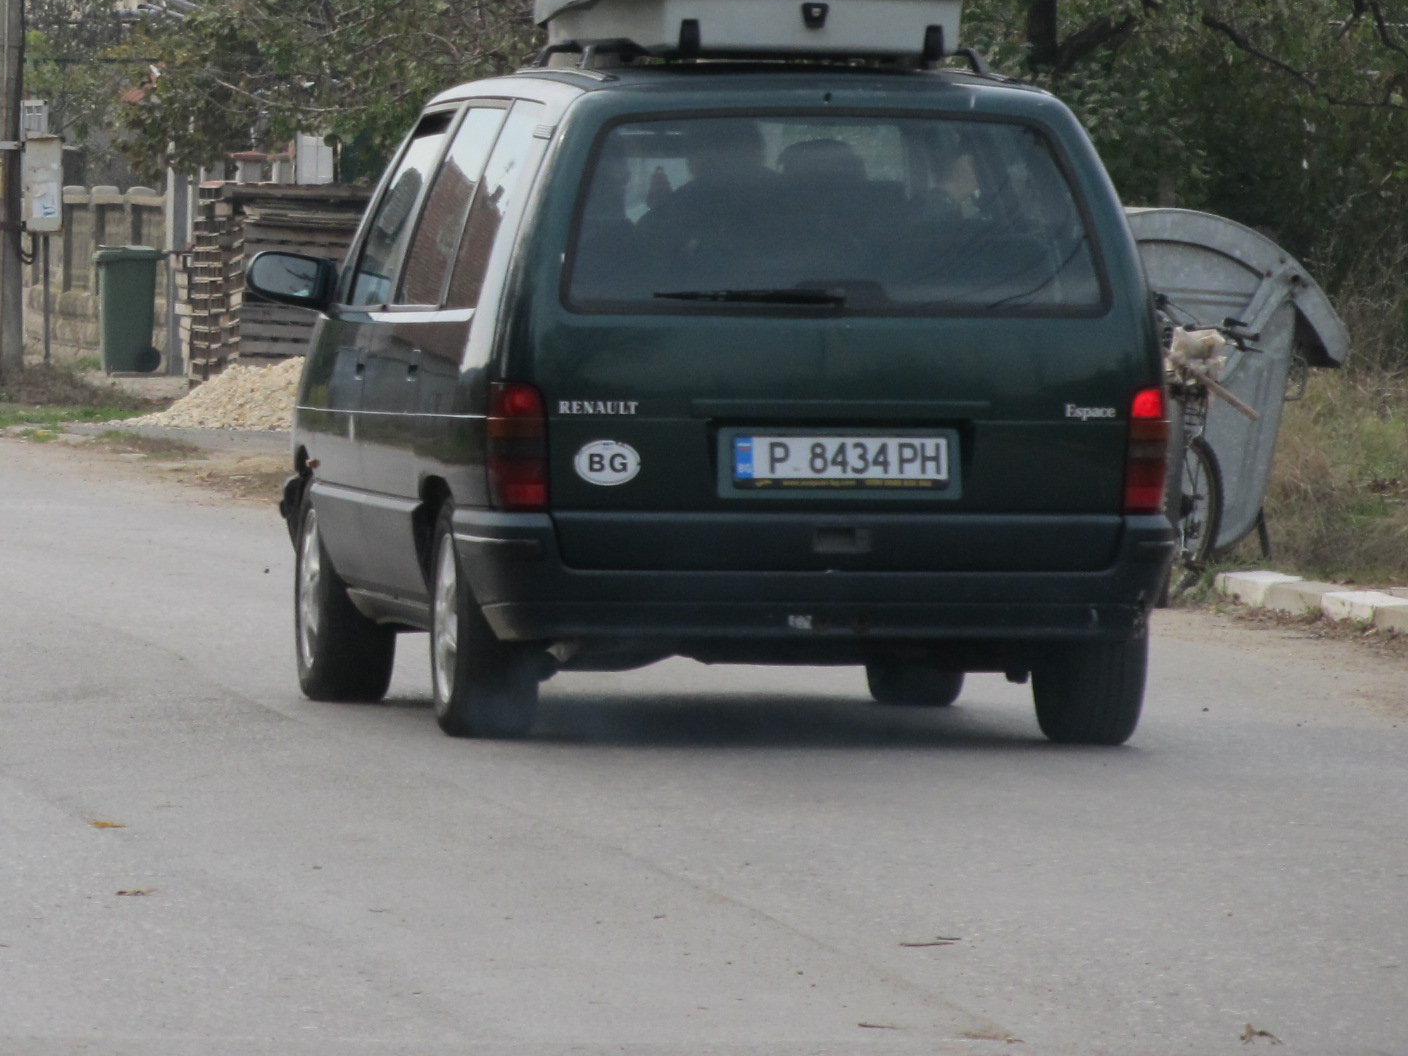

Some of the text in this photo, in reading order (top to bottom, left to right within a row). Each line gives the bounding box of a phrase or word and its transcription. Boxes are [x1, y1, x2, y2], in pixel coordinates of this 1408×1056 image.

[558, 400, 639, 415] RENAULT
[1064, 403, 1117, 422] Espace
[588, 453, 629, 473] BG
